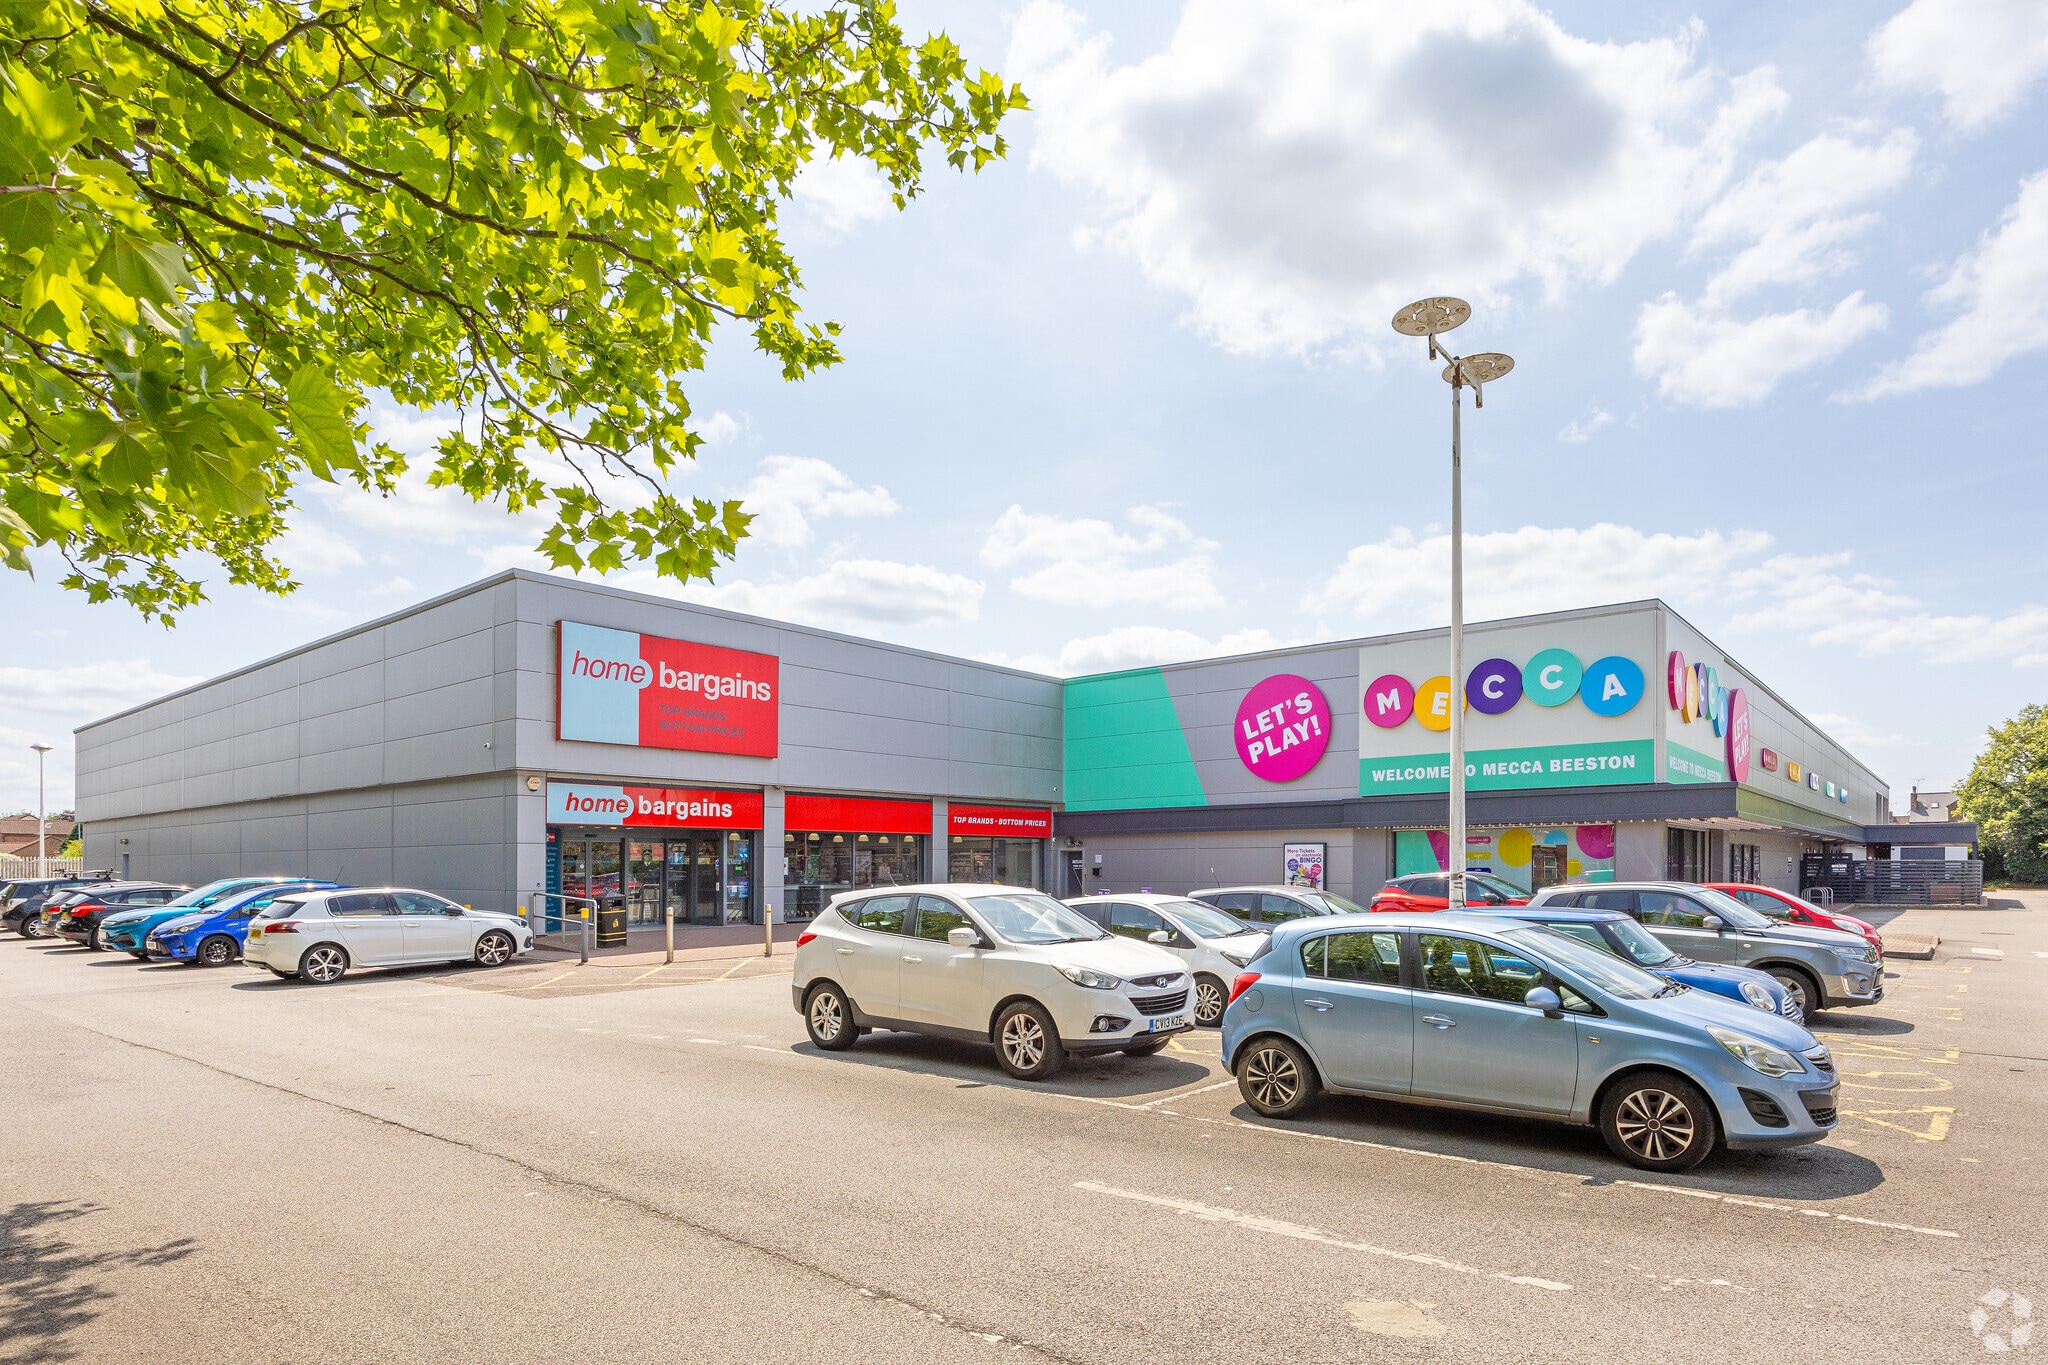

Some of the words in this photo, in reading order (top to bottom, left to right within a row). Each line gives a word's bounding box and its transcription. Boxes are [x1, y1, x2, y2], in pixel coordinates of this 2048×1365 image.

[571, 650, 646, 684] home
[659, 661, 771, 701] bargains
[1376, 664, 1627, 716] MECCA
[659, 704, 681, 715] TOP
[683, 706, 727, 721] BRANDS
[1242, 692, 1313, 740] LET'S
[659, 720, 705, 733] BOTTOM
[708, 725, 745, 738] PRICES
[1247, 714, 1322, 764] PLAY!
[1372, 765, 1450, 782] WELCOME
[1482, 759, 1544, 775] MECCA
[1550, 755, 1635, 772] BEESTON
[565, 792, 629, 813] home
[638, 795, 733, 820] bargains
[953, 816, 966, 824] TOP
[968, 817, 994, 825] BRANDS
[998, 818, 1023, 826] BOTTOM
[1155, 1018, 1170, 1029] CV13
